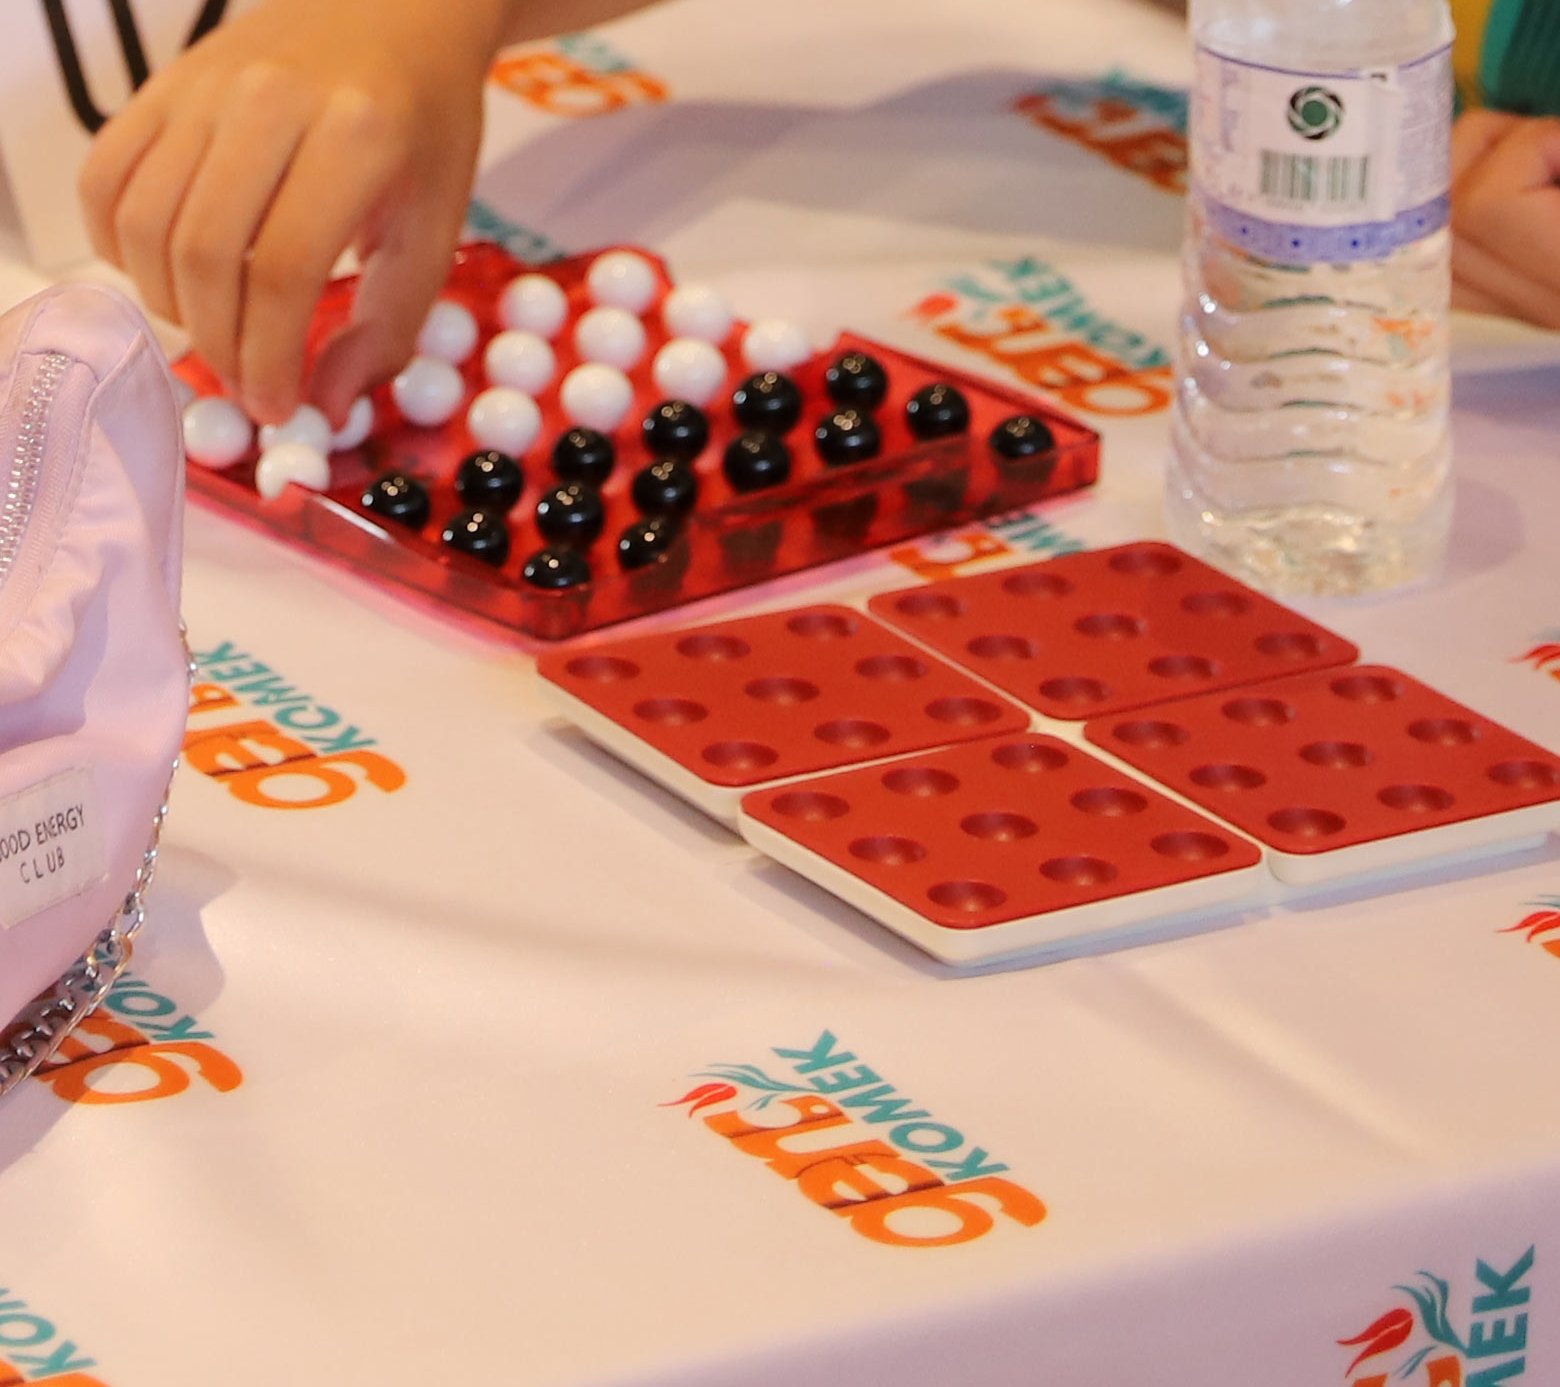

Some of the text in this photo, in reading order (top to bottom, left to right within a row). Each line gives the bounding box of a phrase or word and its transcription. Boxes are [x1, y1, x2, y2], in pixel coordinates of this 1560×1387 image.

[35, 803, 85, 846] ENERGY
[19, 846, 66, 884] CLUB
[770, 1028, 1011, 1182] KOMEK
